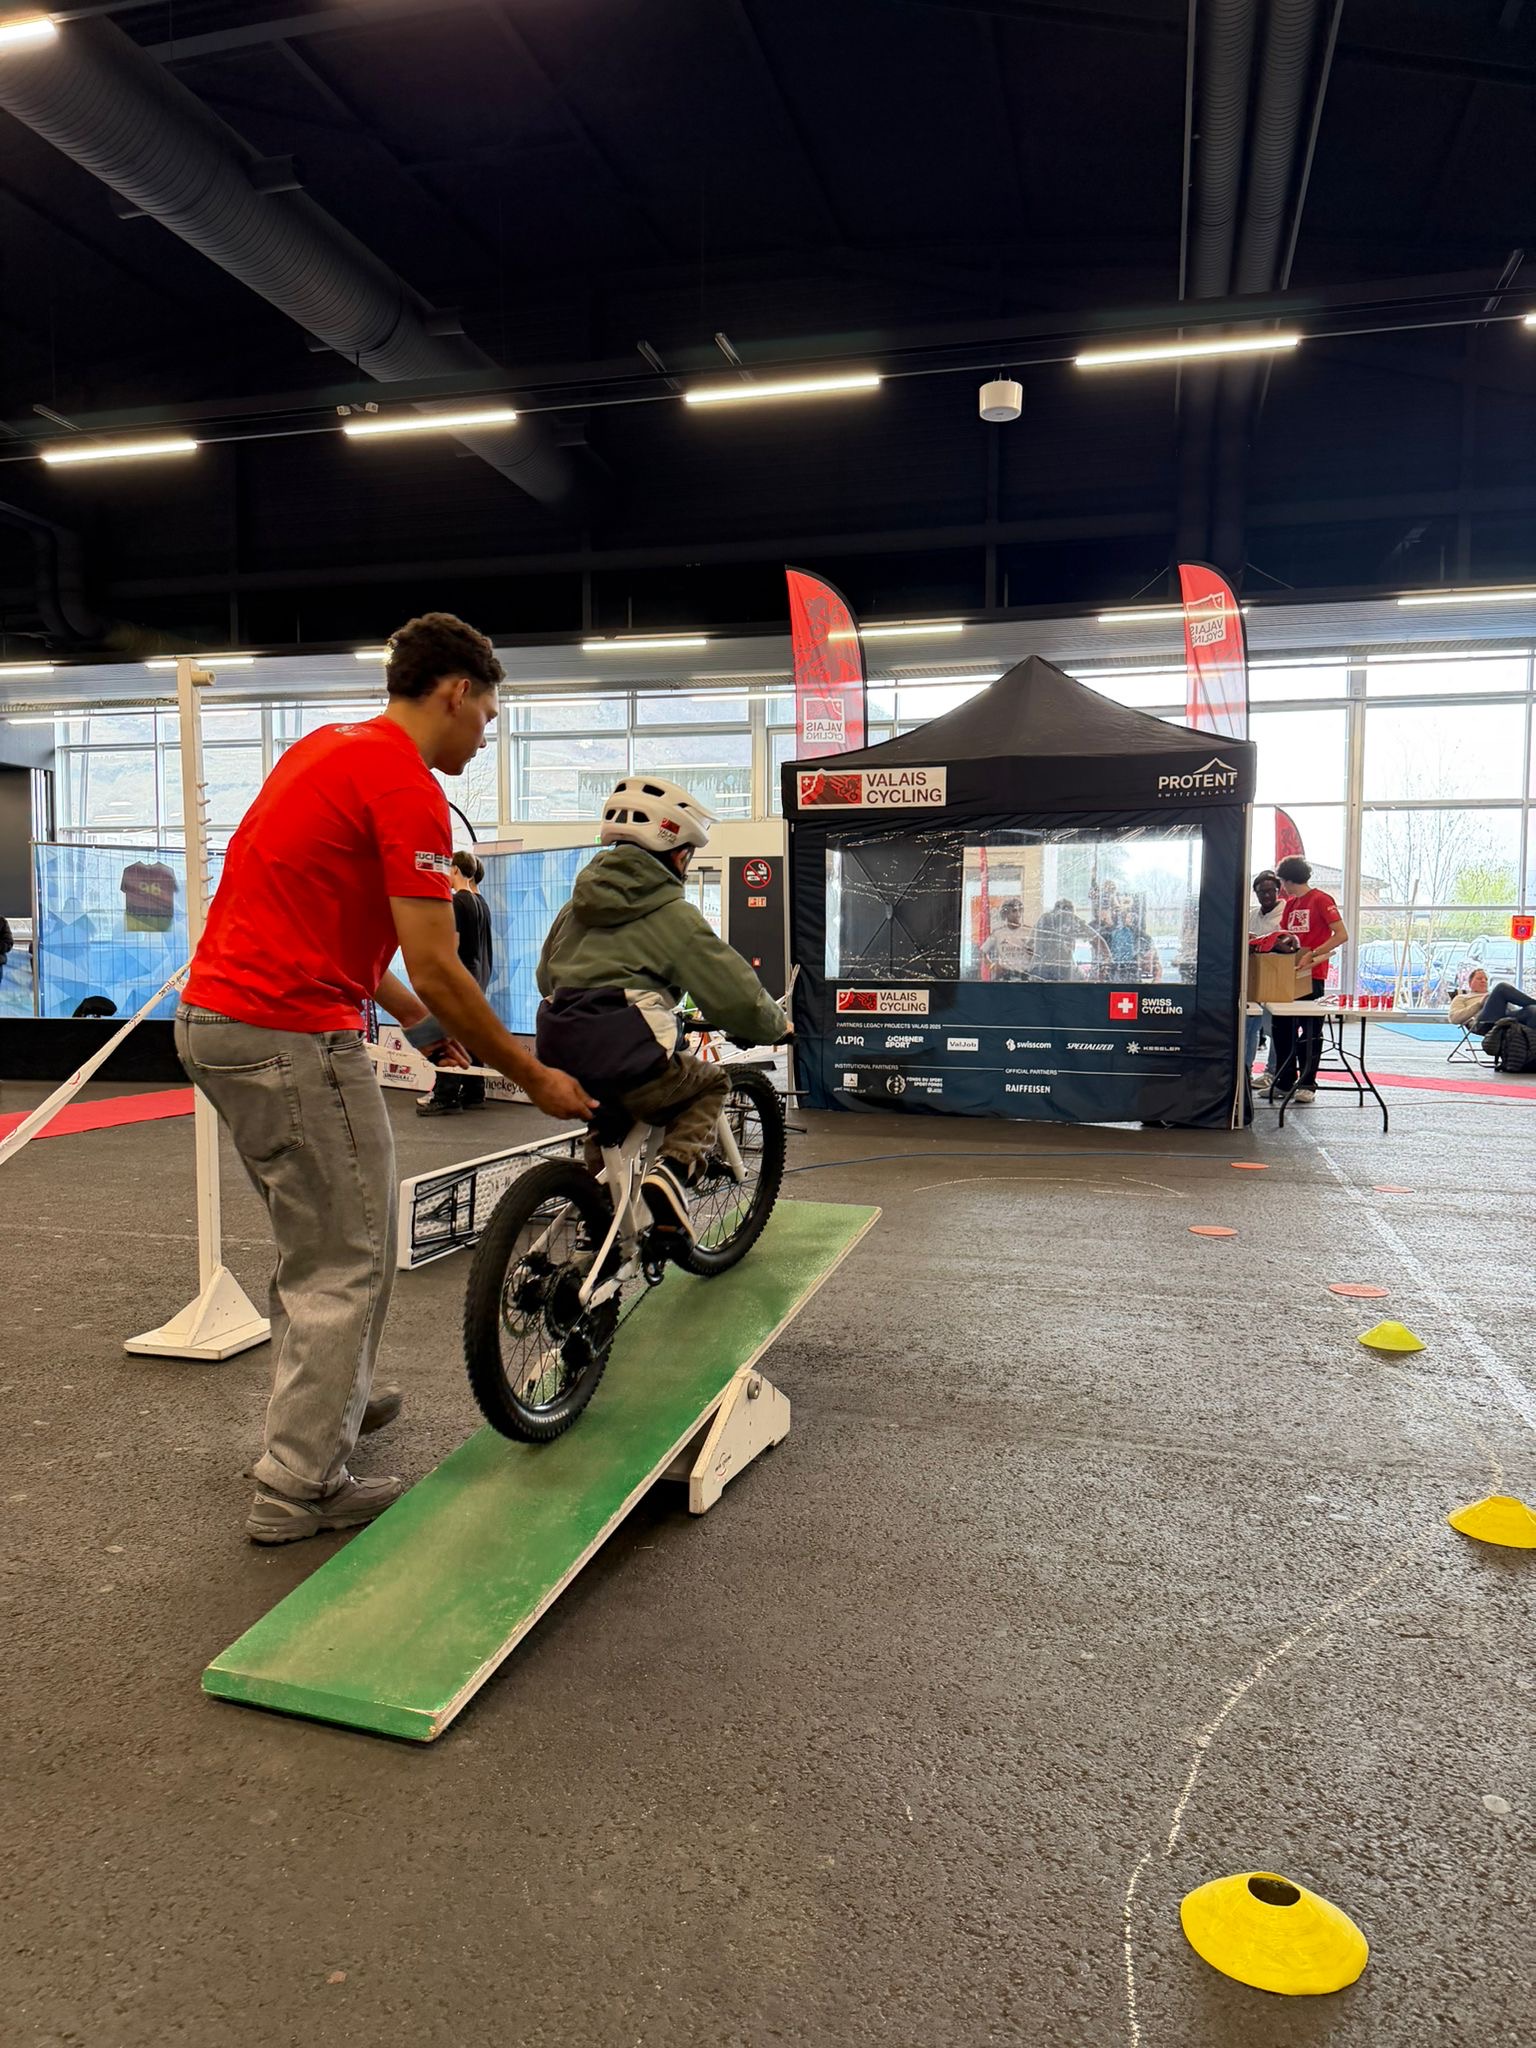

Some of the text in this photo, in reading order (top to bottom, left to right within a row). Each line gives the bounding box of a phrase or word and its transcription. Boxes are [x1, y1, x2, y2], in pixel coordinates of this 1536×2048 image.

[866, 772, 927, 787] VALAIS
[1158, 772, 1238, 790] PROTENT
[866, 788, 942, 804] CYCLING
[880, 992, 917, 1001] VALAIS
[880, 1002, 927, 1012] CYCLING
[1141, 998, 1172, 1007] SWISS
[1141, 1006, 1183, 1015] CYCLING
[835, 1035, 865, 1047] ALPIQ
[885, 1041, 912, 1049] SPORT
[1017, 1041, 1052, 1049] swisscom
[1066, 1042, 1115, 1051] SPECIALIZED
[1005, 1067, 1029, 1075] OFFICIAL
[1005, 1083, 1051, 1094] RAIFFEISEN
